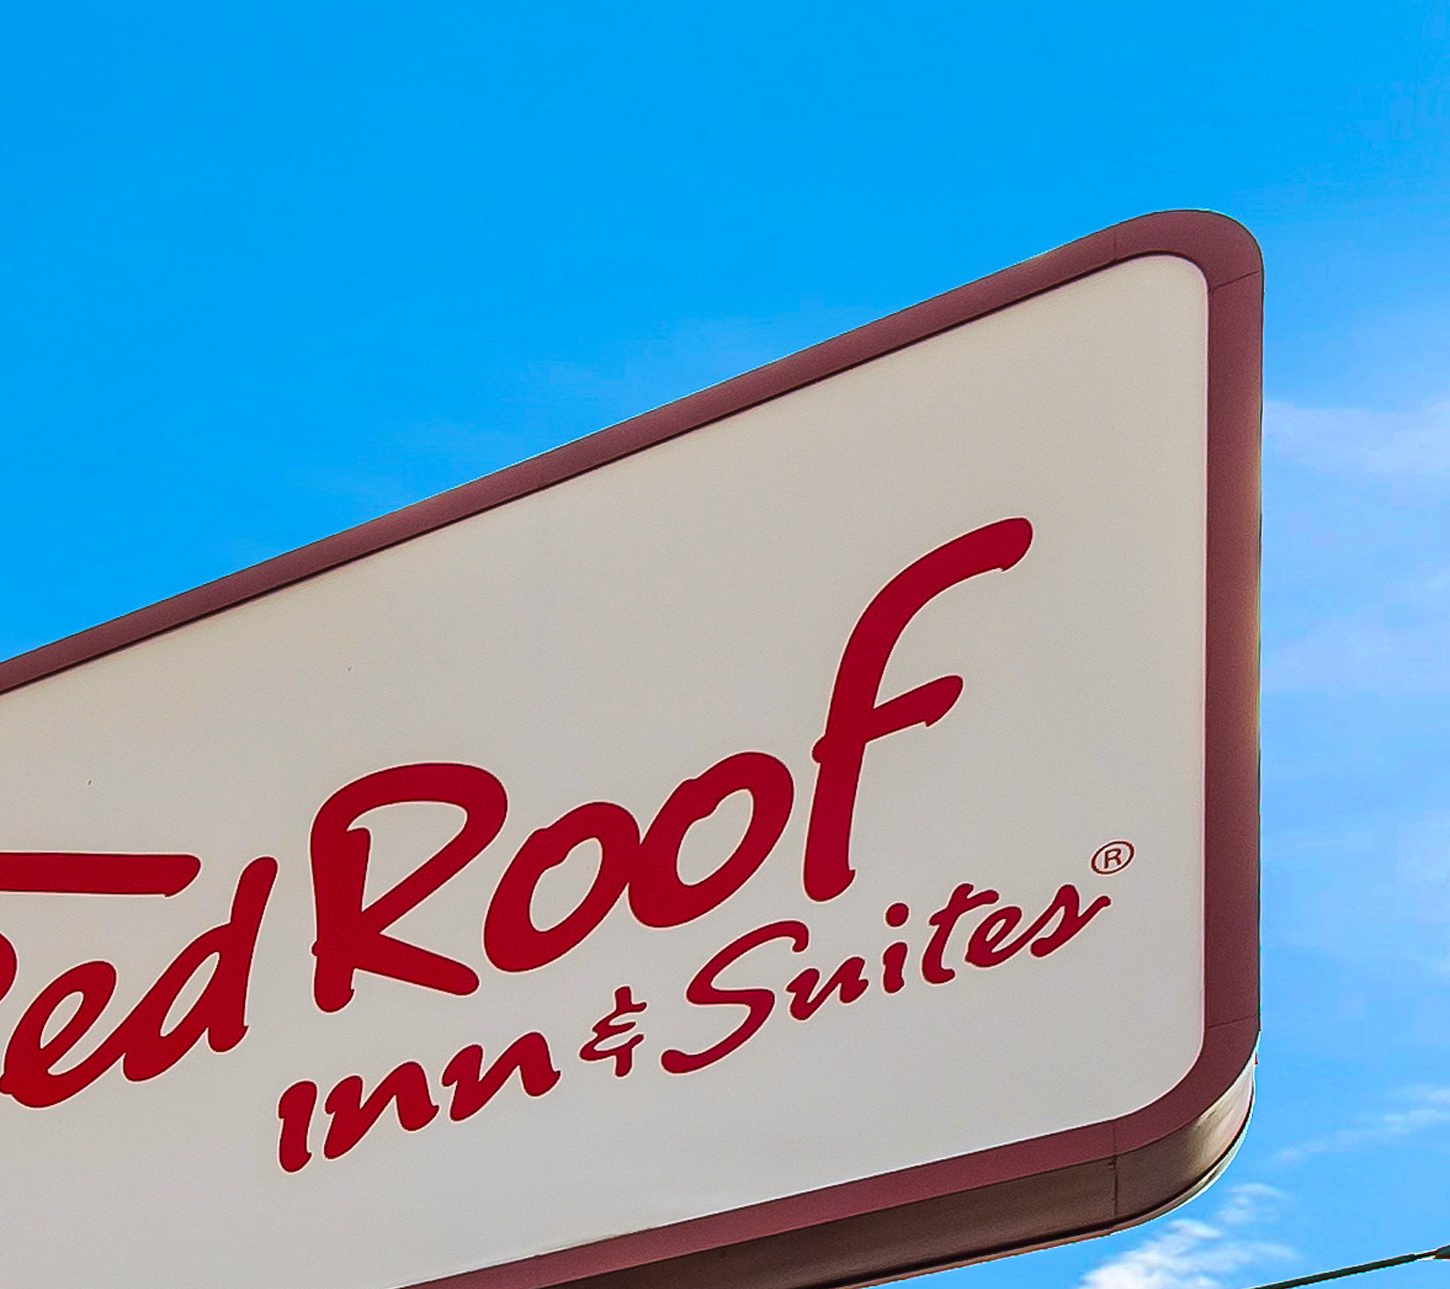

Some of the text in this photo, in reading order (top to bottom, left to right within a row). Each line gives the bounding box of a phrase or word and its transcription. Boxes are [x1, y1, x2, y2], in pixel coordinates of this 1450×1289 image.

[310, 517, 1034, 1013] Roof
[278, 1032, 561, 1173] Inn
[580, 986, 647, 1077] &
